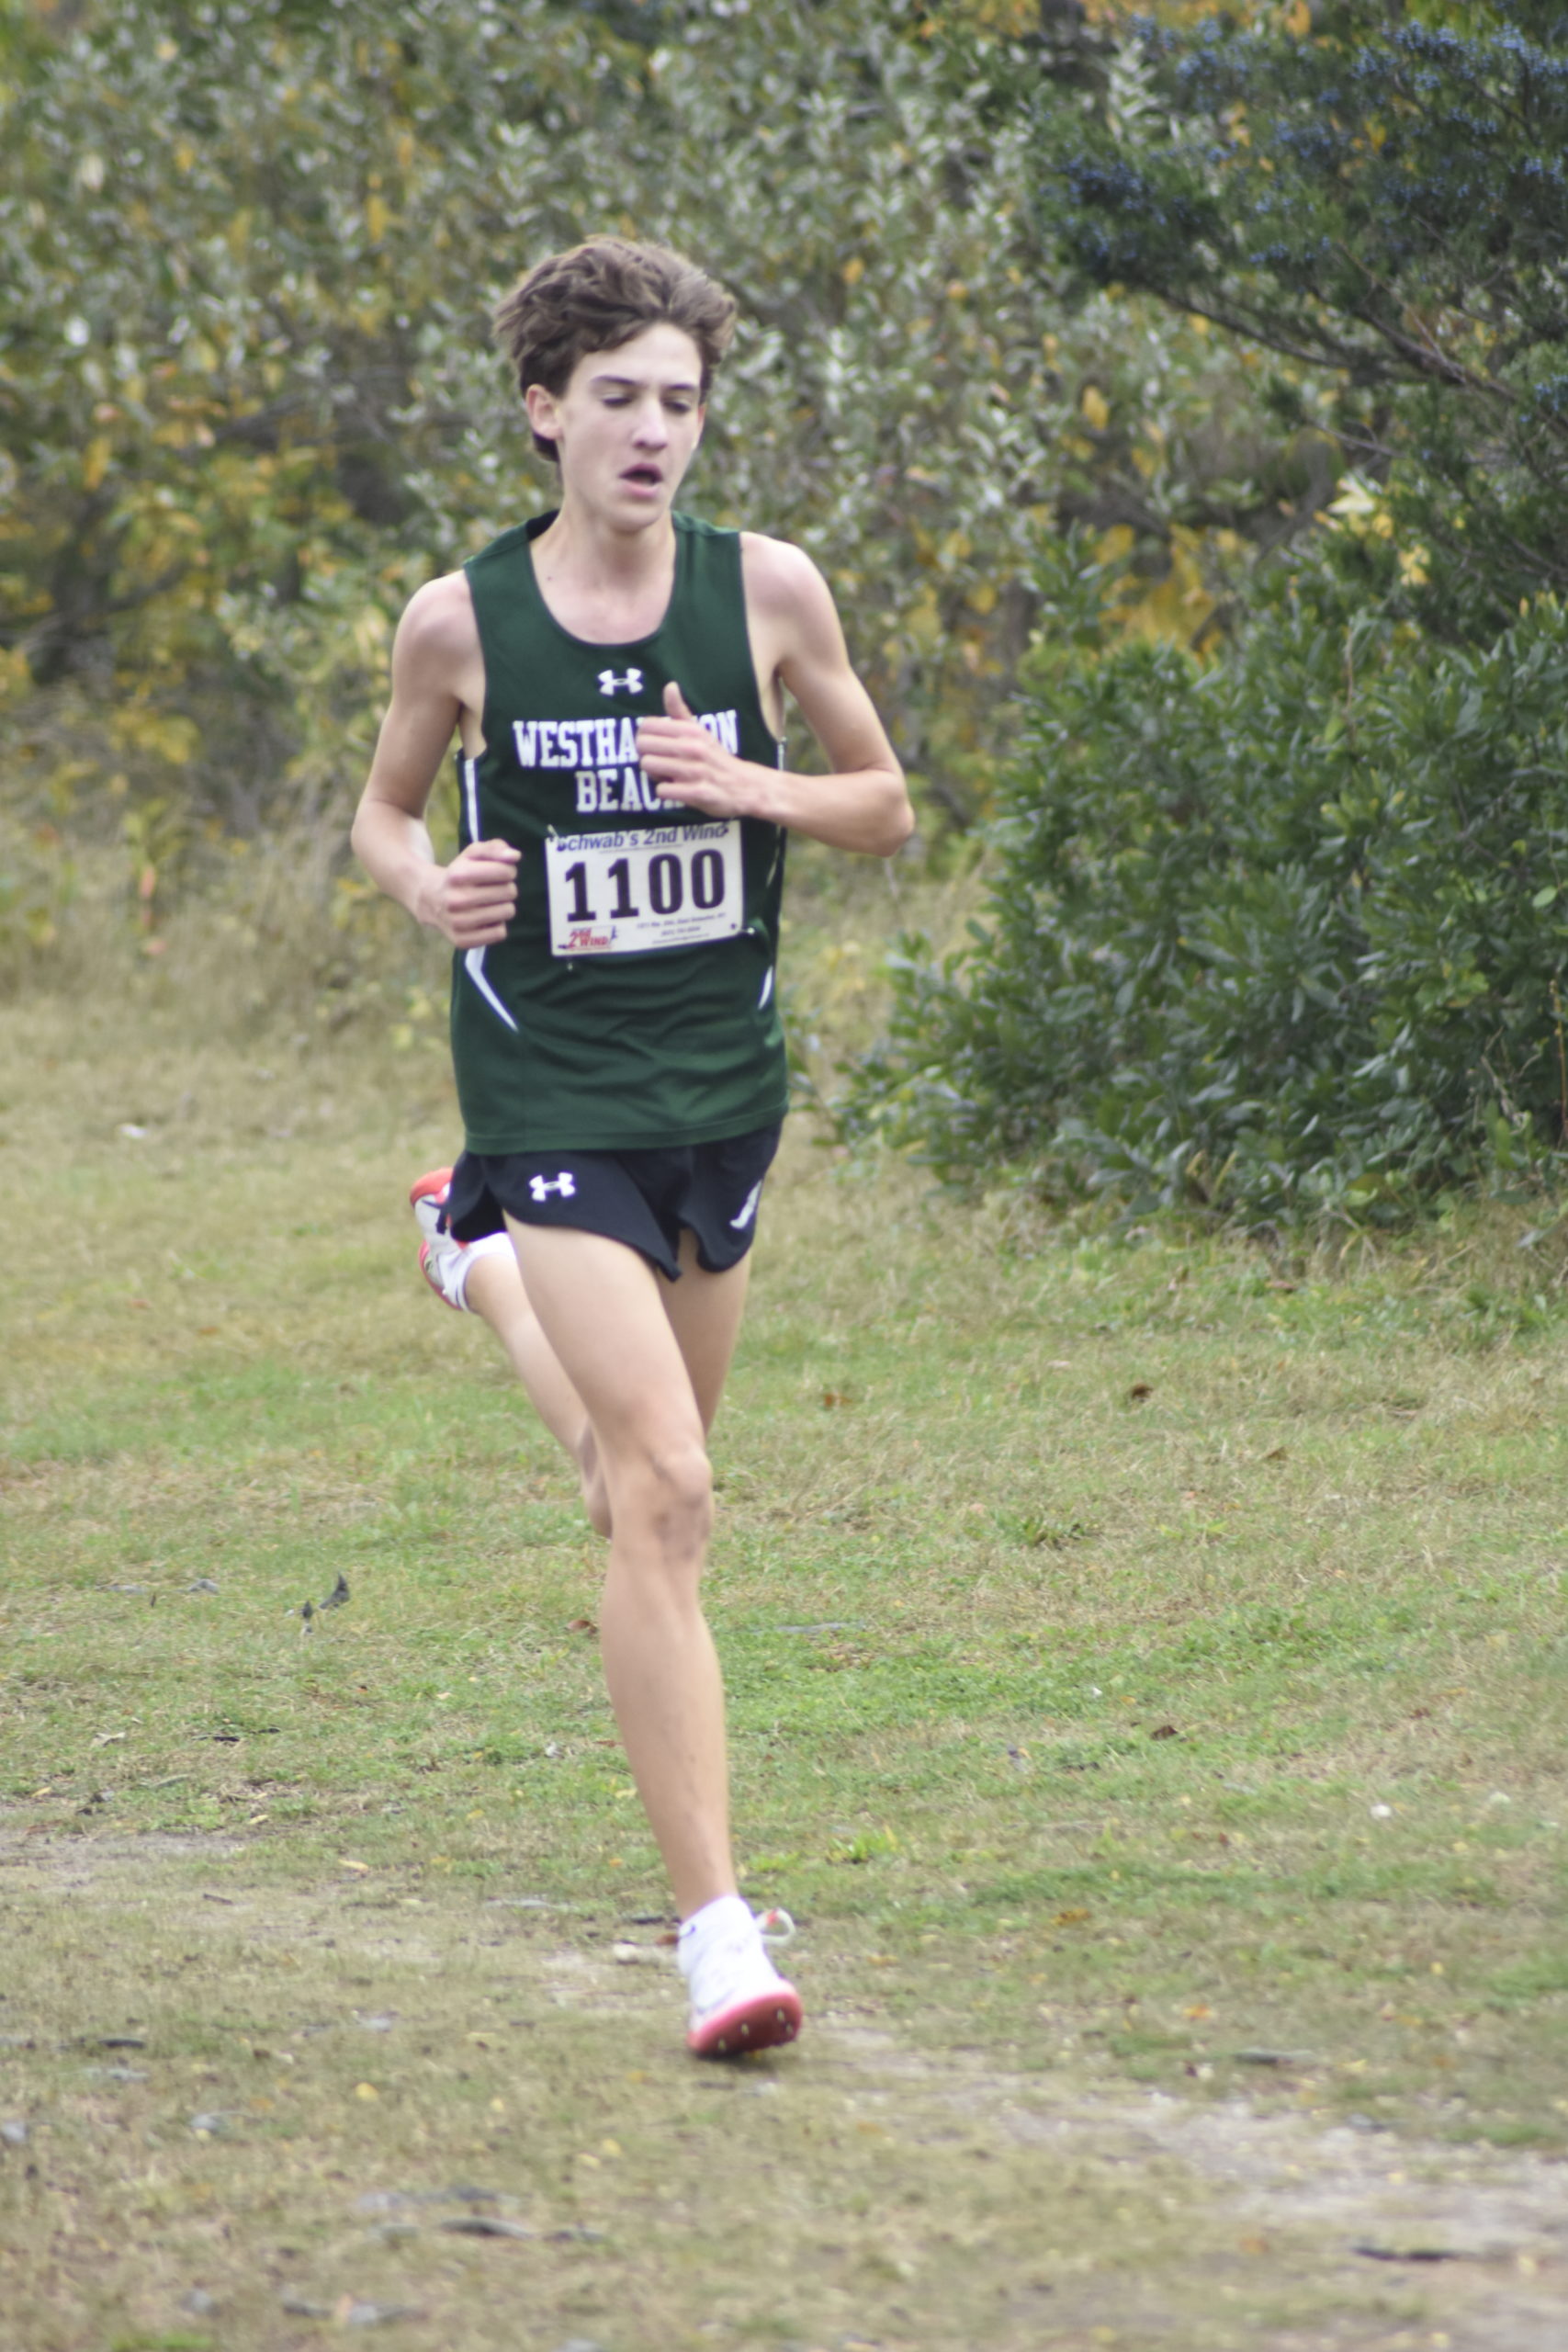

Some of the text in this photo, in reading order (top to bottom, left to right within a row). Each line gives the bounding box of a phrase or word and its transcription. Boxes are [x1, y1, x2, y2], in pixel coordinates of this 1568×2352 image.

[513, 709, 739, 768] WESTHAON
[575, 767, 686, 812] BEAC
[557, 831, 638, 852] Schwab's
[643, 826, 678, 845] 2nd
[682, 822, 728, 842] Wind
[565, 849, 725, 922] 1100
